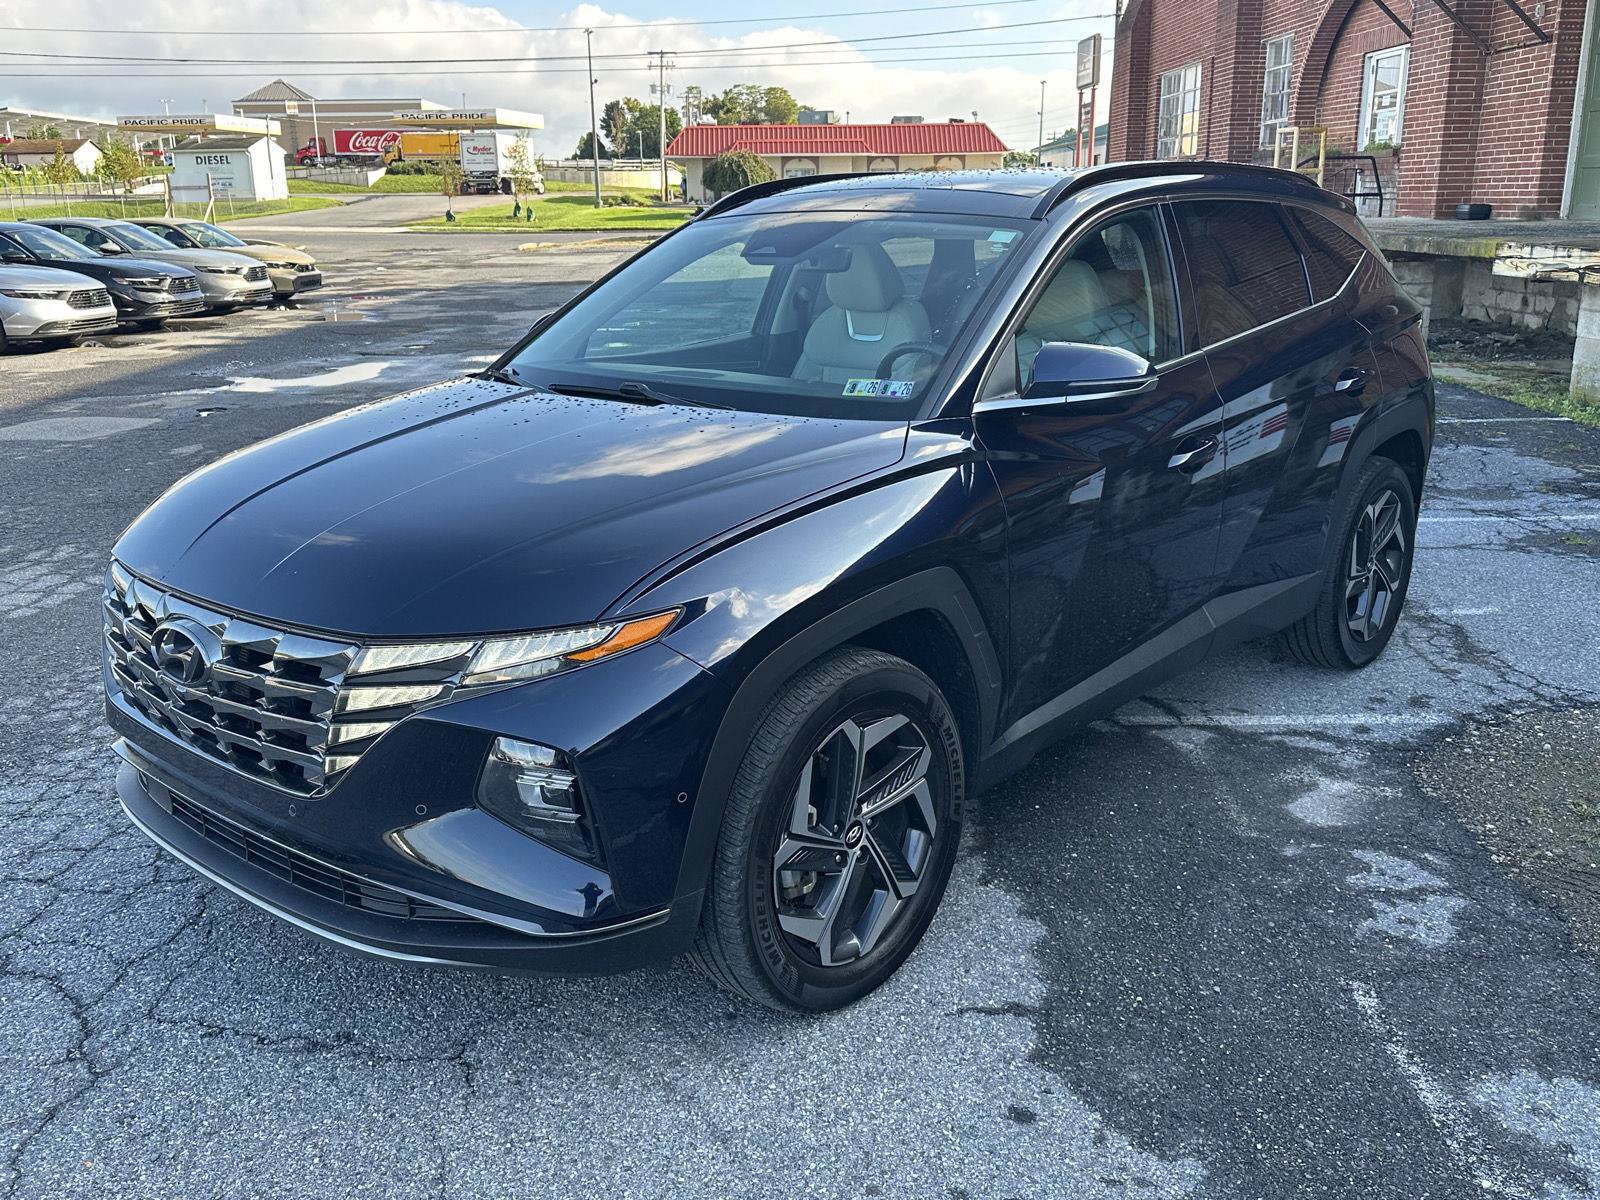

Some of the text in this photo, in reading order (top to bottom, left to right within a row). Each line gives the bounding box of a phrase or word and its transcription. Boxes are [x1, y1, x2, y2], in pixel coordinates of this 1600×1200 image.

[349, 131, 401, 152] Coca-Col
[195, 155, 231, 165] DIESEL
[850, 382, 878, 393] 9 26
[881, 383, 912, 395] 9 26
[943, 725, 962, 816] MICHELIN
[756, 865, 781, 966] MICHELIN
